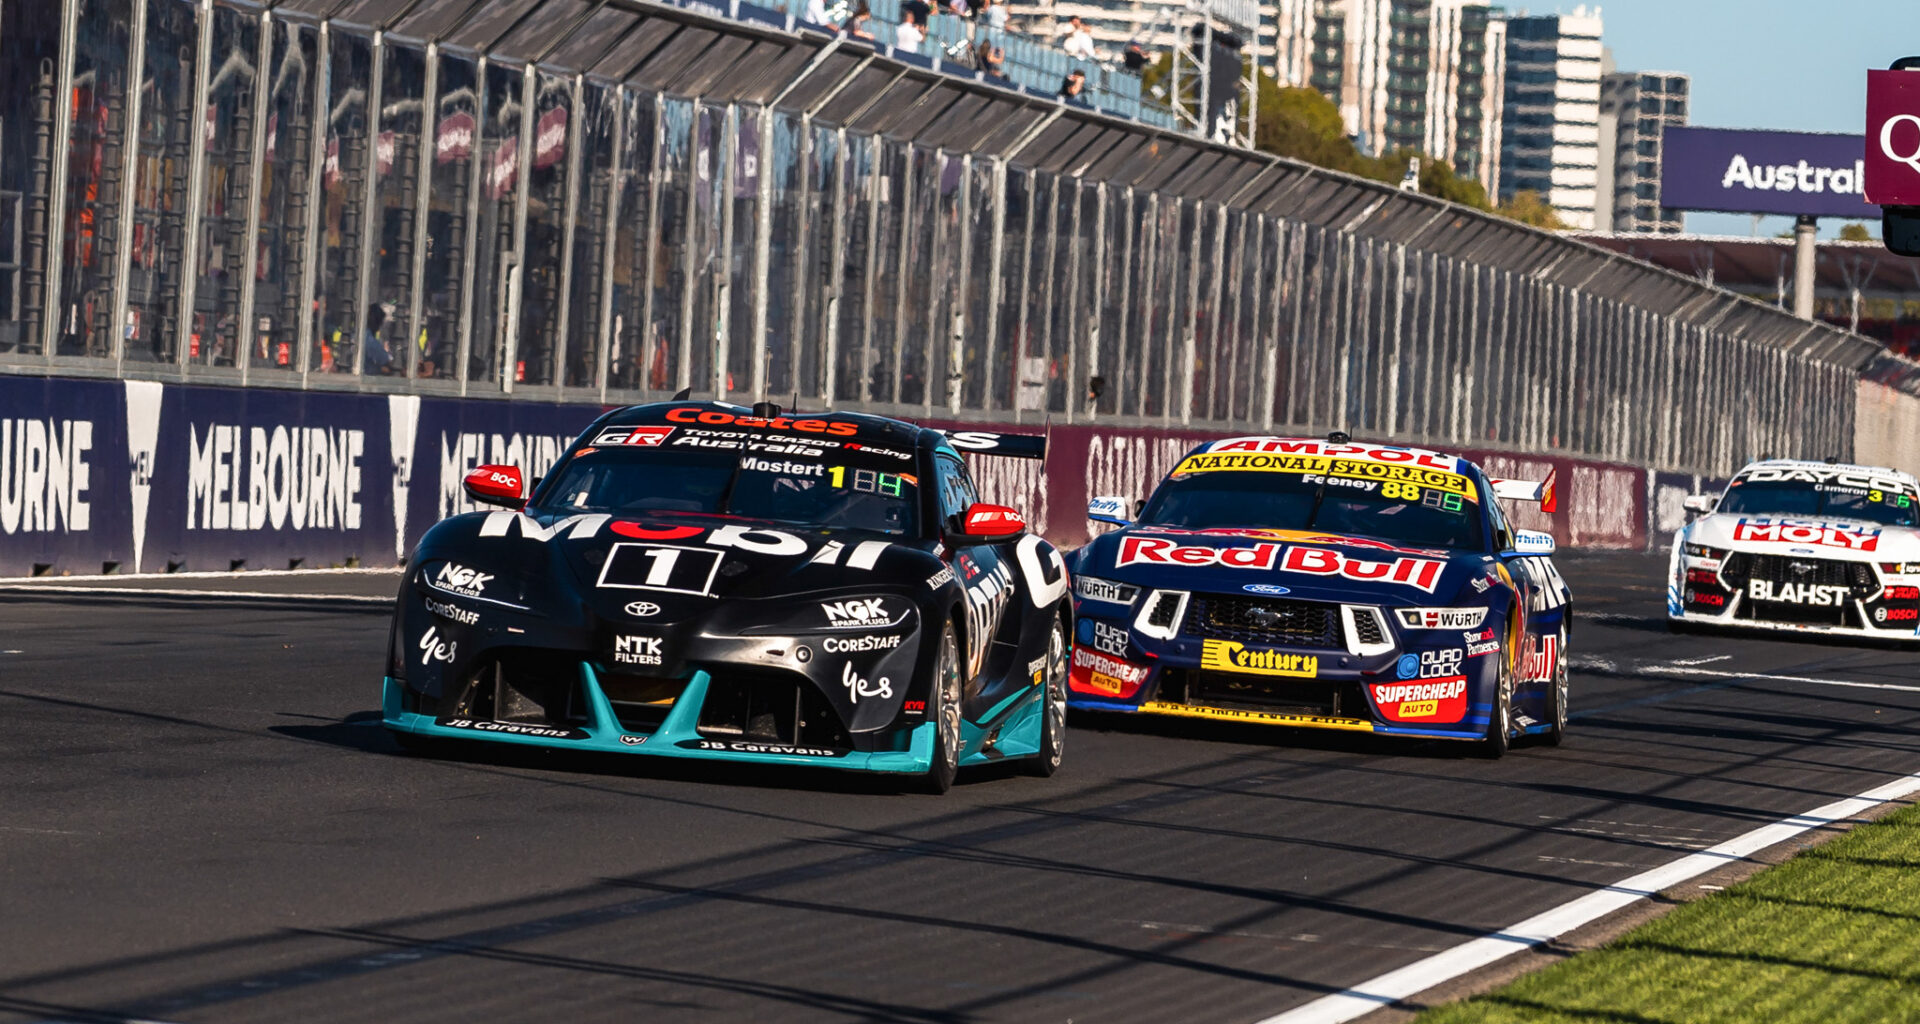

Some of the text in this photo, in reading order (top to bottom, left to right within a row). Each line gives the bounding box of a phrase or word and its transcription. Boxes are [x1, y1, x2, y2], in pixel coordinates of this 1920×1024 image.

[664, 407, 859, 436] Coates
[595, 432, 666, 446] GR
[673, 436, 823, 457] Australia
[684, 428, 912, 460] TOYOTA GAZOO Racing
[1215, 440, 1451, 470] AMPOL
[187, 421, 364, 532] MELBOURNE
[490, 472, 517, 487] BOC
[740, 457, 824, 477] Mostert
[828, 466, 845, 488] 1
[1185, 455, 1463, 490] NATIONAL STORAGE
[1747, 469, 1909, 494] DAYCO
[1302, 473, 1377, 491] Feeney
[1381, 482, 1420, 501] 88
[1814, 484, 1868, 496] Cameron
[1868, 490, 1883, 502] 3
[478, 511, 893, 572] Mobil
[1516, 534, 1553, 548] Thrifty
[1741, 526, 1878, 548] MOLY
[437, 561, 495, 591] NGK
[644, 548, 681, 586] 1
[1116, 536, 1282, 570] Red
[1281, 545, 1447, 594] Bull
[456, 586, 481, 597] PLUGS
[1695, 592, 1724, 607] BOSCH
[1749, 579, 1849, 606] BLAHST
[821, 598, 888, 620] NGK
[1887, 608, 1918, 620] BOSCH
[1095, 621, 1129, 643] QUAD
[615, 635, 663, 654] NTK
[1094, 635, 1128, 658] LOCK
[615, 653, 662, 665] FILTERS
[1218, 640, 1318, 677] Century
[1421, 648, 1463, 664] QUAD
[1420, 661, 1461, 678] LOCK
[1094, 676, 1118, 689] AUTO
[1375, 680, 1466, 704] SUPERCHEAP
[1402, 704, 1433, 714] AUTO
[446, 718, 570, 738] JB Caravans
[699, 740, 834, 757] JB Caravans
